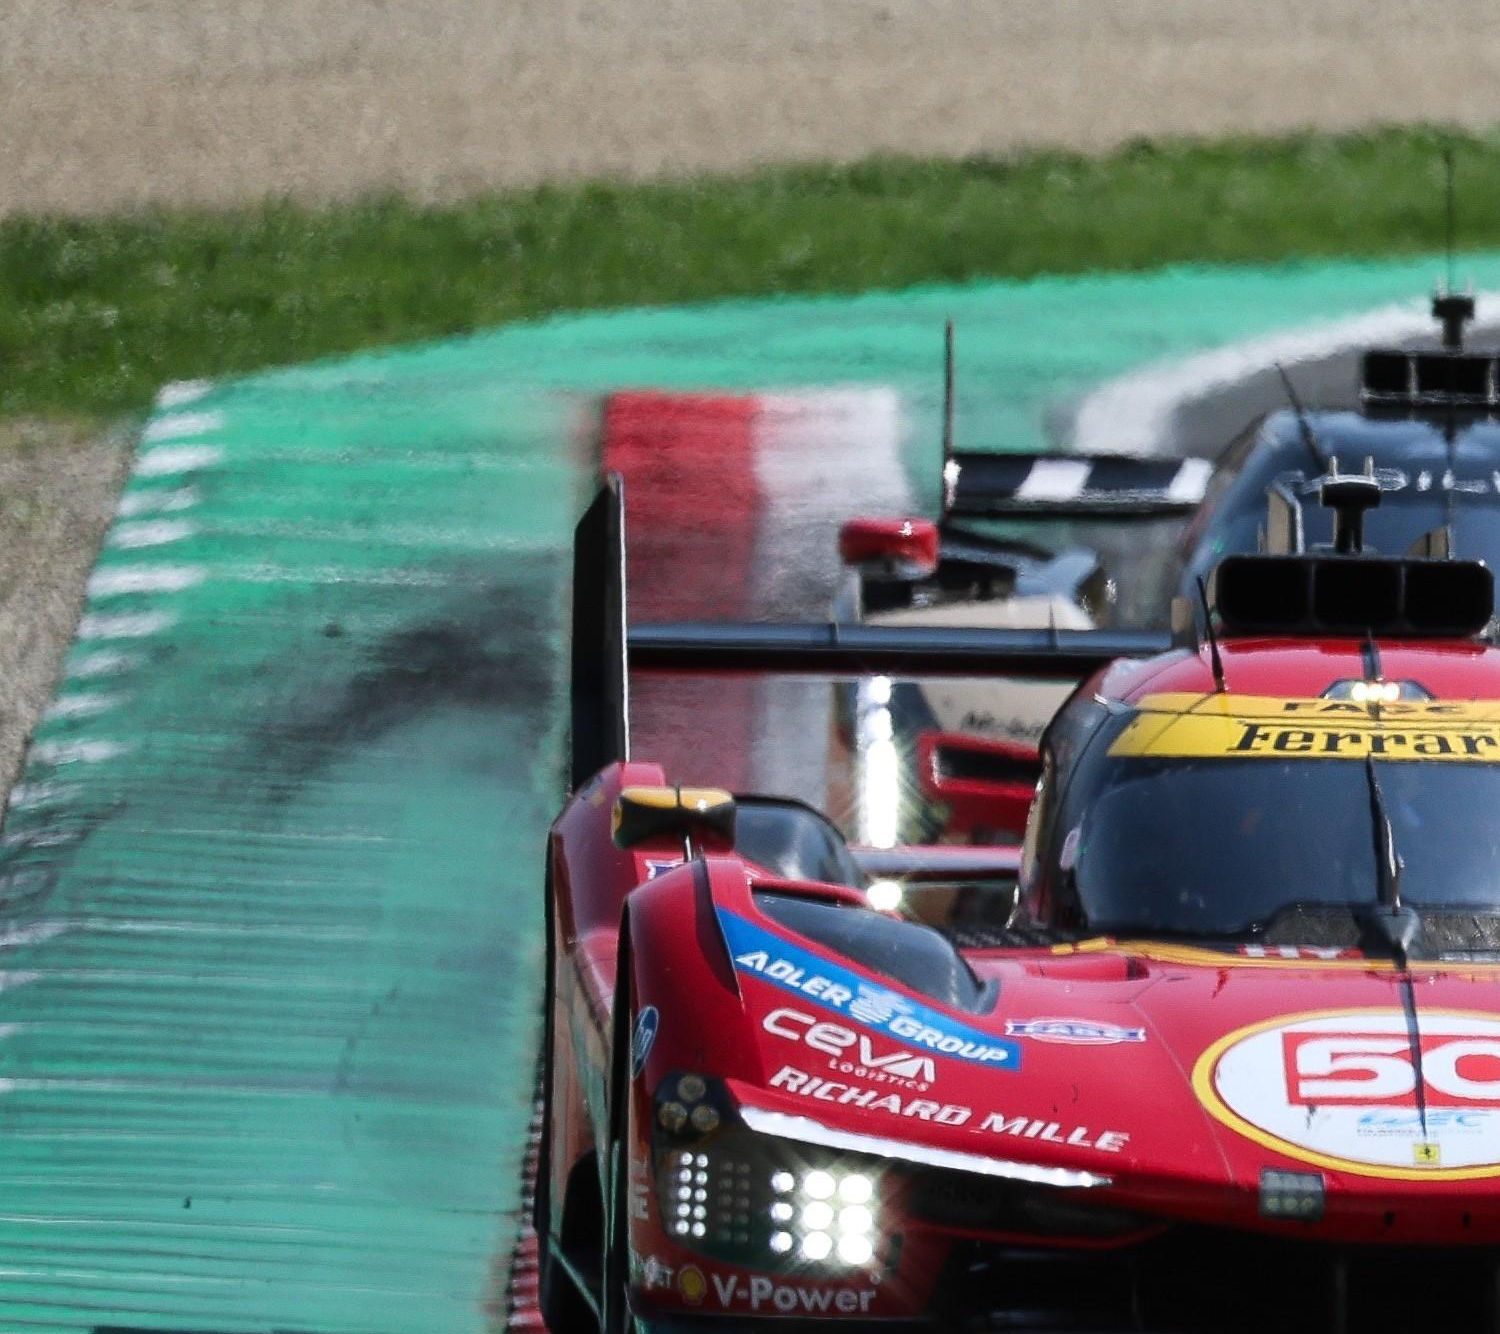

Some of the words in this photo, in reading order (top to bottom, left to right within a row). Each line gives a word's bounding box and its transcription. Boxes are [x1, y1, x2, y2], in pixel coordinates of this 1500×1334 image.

[736, 950, 852, 1008] ADLER
[886, 1017, 1009, 1064] GROUP
[768, 1065, 972, 1127] RICHARD
[974, 1110, 1131, 1154] MILLE
[712, 1273, 876, 1312] V-Power
